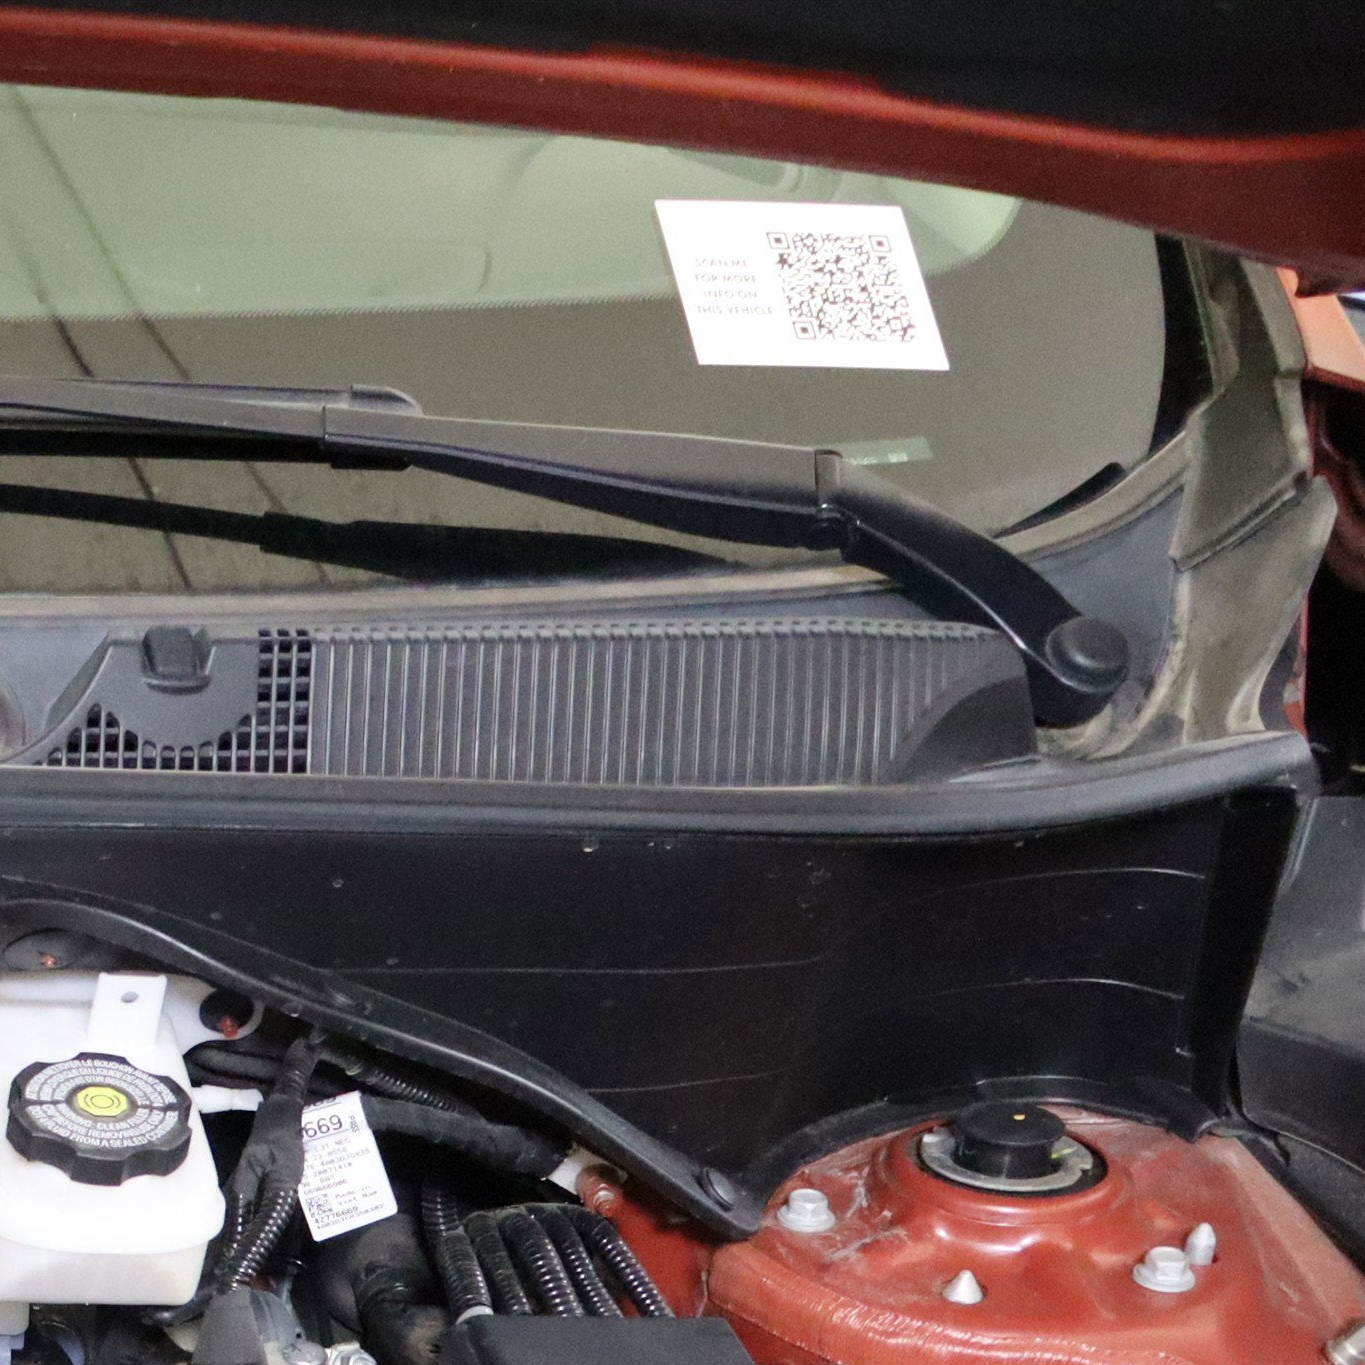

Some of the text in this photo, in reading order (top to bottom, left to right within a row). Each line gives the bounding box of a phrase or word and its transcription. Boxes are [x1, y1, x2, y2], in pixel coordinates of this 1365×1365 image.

[694, 258, 728, 268] SCAN
[694, 273, 757, 284] FOR MORE
[703, 289, 758, 300] INFO ON
[696, 305, 773, 316] THIS VEHICLE
[68, 1133, 100, 1146] FROM
[109, 1135, 149, 1147] SEALED
[313, 1205, 360, 1225] 42776669
